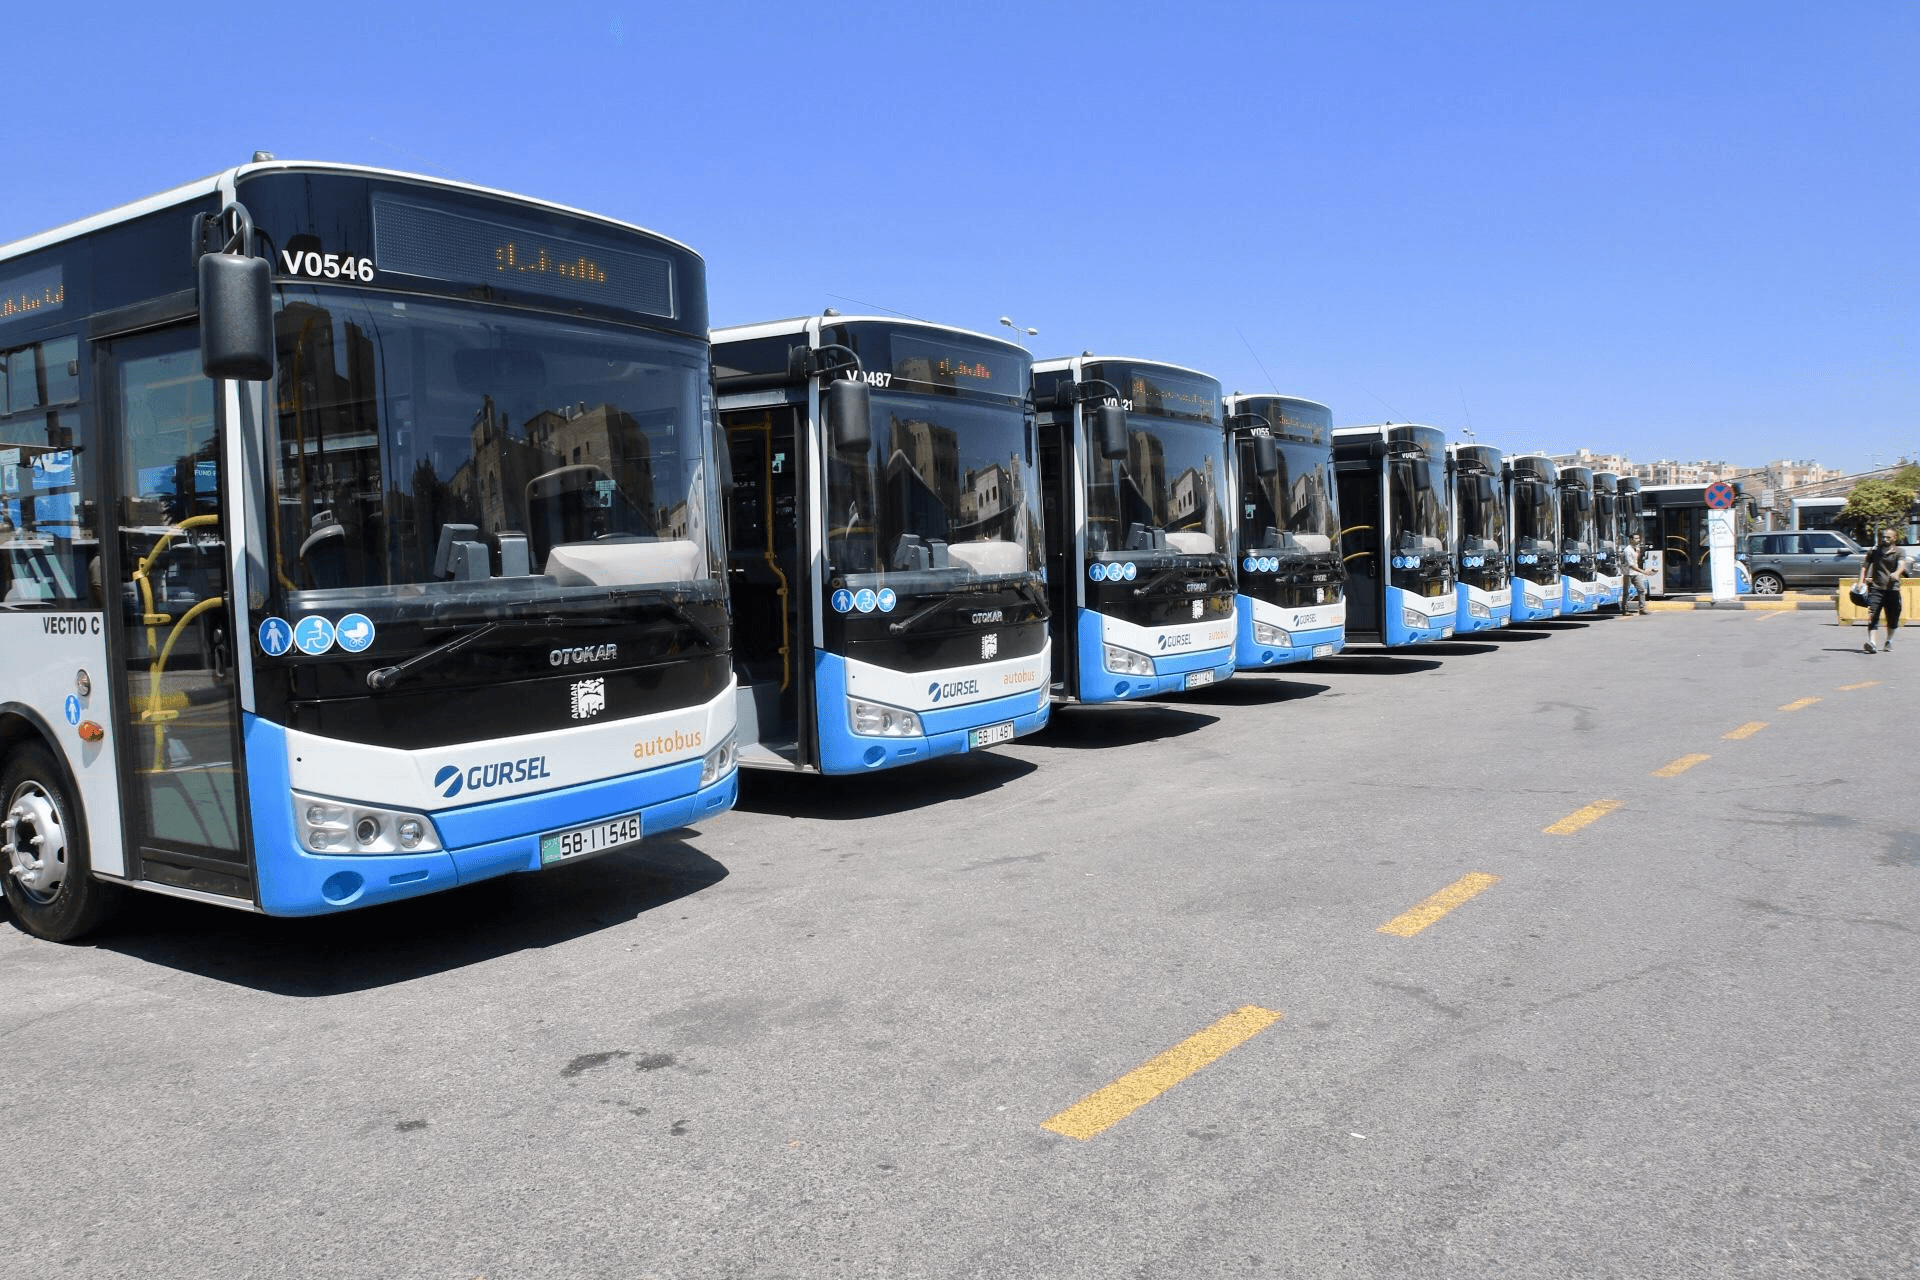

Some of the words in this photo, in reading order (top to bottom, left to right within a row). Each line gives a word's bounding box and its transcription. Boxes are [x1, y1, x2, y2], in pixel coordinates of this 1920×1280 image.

[282, 250, 374, 282] V0546
[1103, 397, 1133, 412] V021
[43, 616, 87, 635] VECTIO
[91, 616, 100, 635] C
[972, 610, 1003, 624] OTOKAR
[550, 643, 618, 666] OTOKAR
[1003, 668, 1036, 685] autobus
[570, 683, 580, 719] AMMAN
[633, 729, 702, 759] autobus
[466, 755, 551, 790] GÜRSEL
